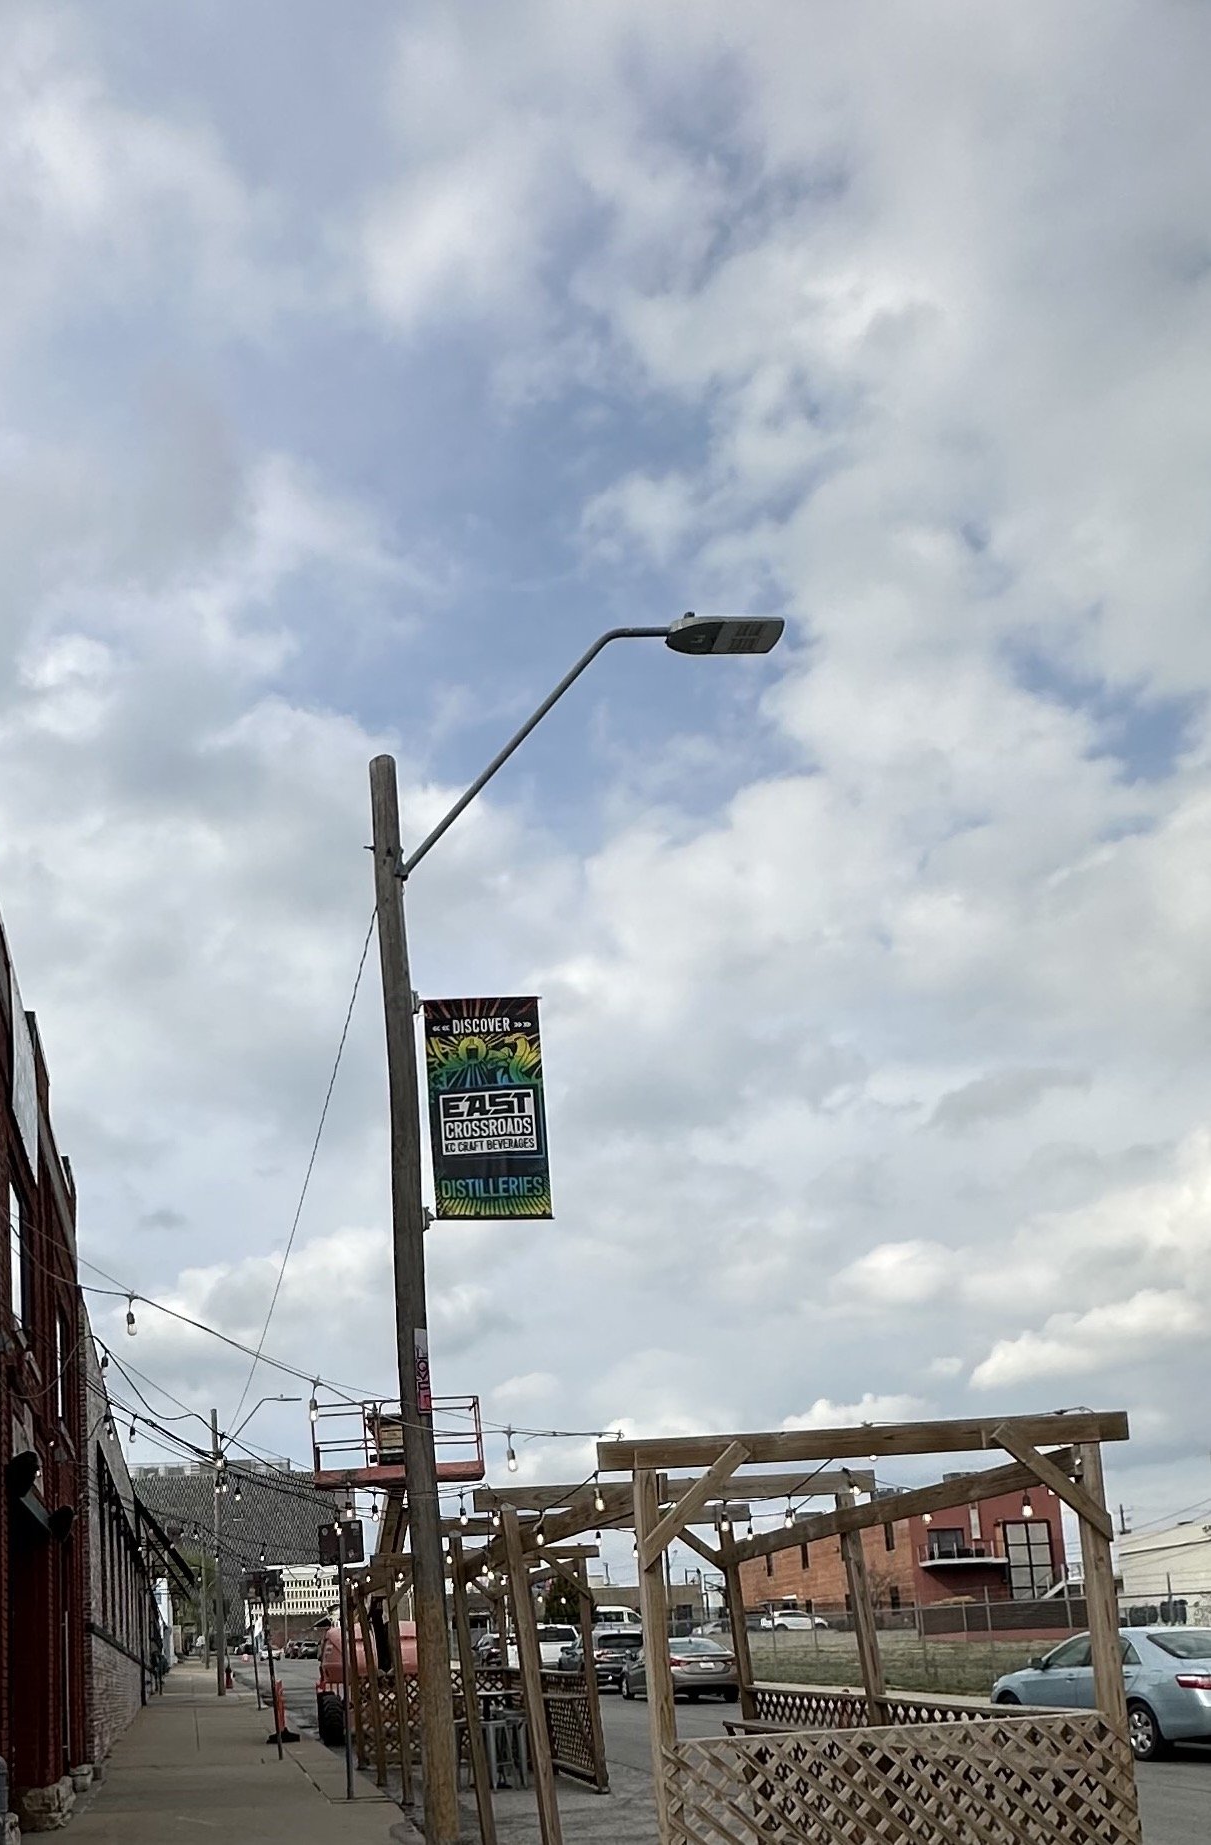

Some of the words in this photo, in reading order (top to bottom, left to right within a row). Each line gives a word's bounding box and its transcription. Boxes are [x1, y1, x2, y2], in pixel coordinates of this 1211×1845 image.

[452, 1017, 511, 1034] DISCOVER
[442, 1092, 532, 1118] EAST
[445, 1117, 532, 1139] CROSSROADS
[445, 1142, 456, 1153] KC
[457, 1140, 484, 1152] CRAFT
[486, 1137, 535, 1150] BEVERAGES
[441, 1176, 544, 1198] DISTILLERIES
